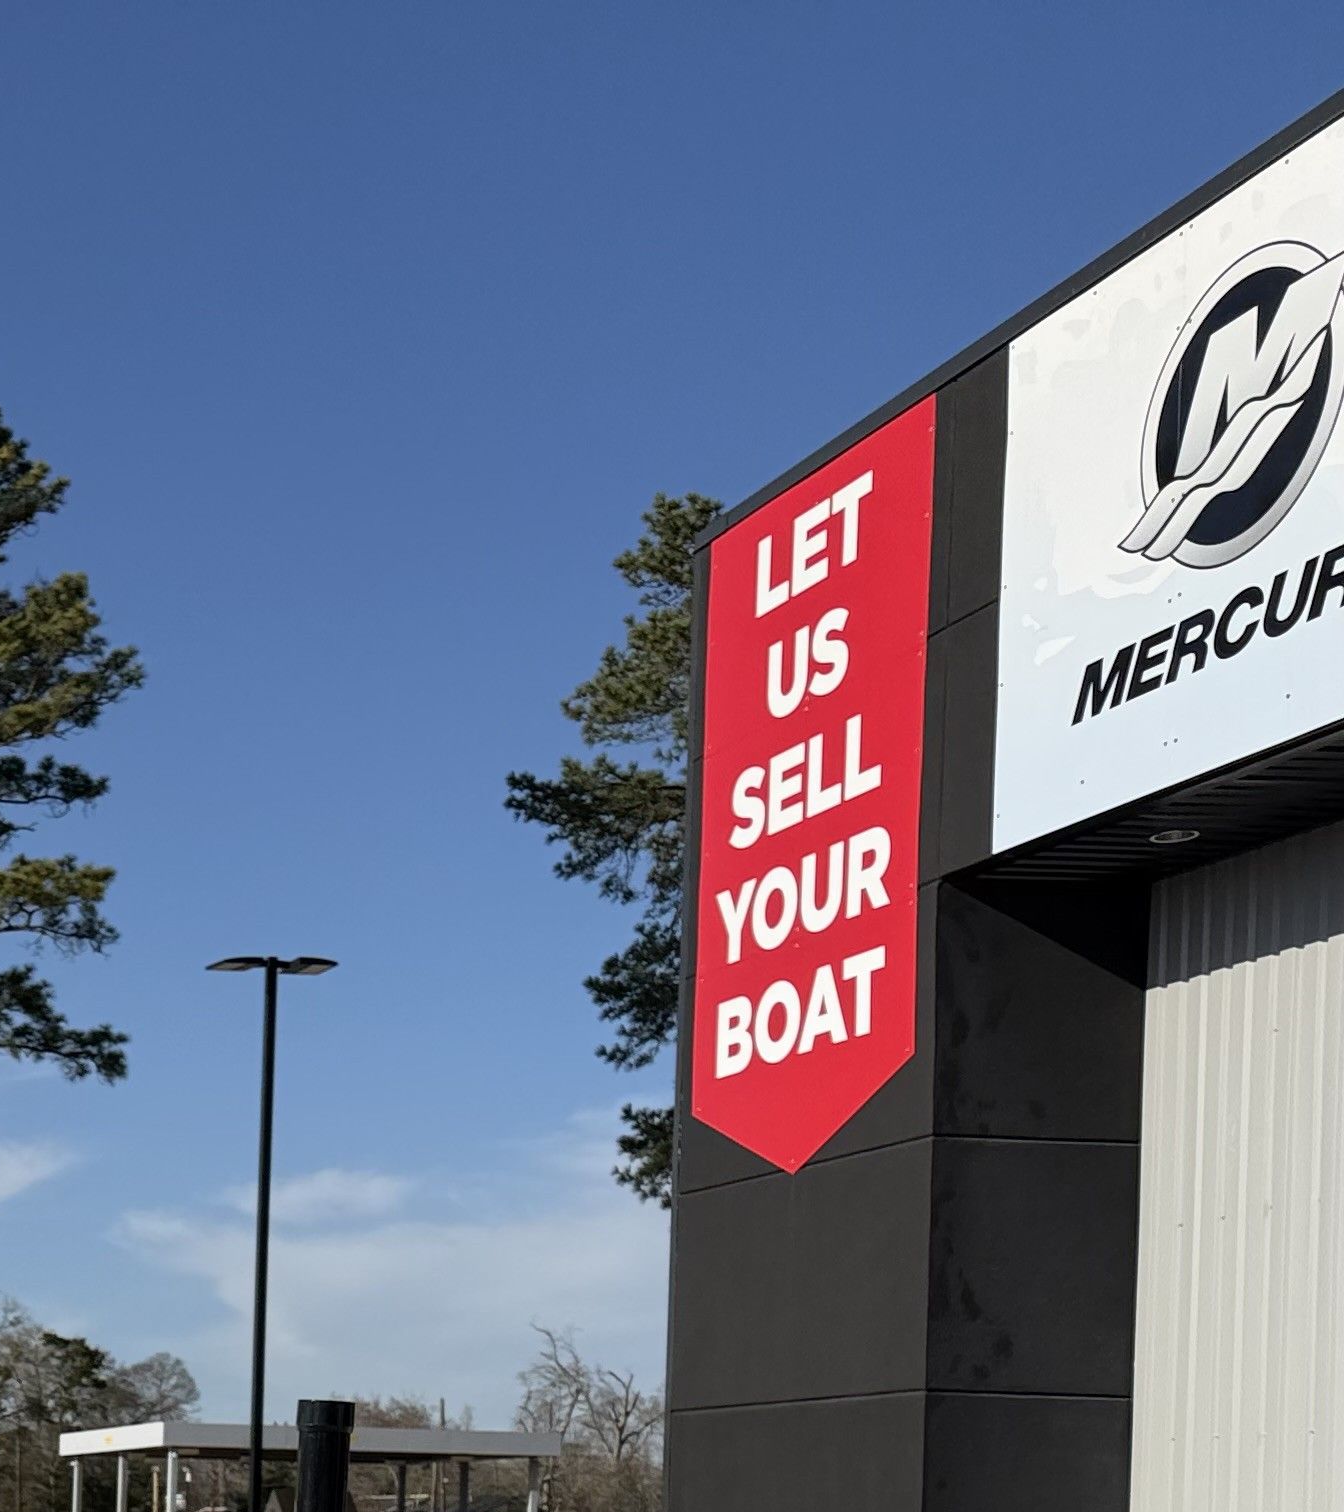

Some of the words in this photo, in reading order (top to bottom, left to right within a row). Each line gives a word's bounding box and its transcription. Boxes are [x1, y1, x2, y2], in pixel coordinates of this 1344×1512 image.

[754, 469, 872, 618] LET
[767, 607, 848, 719] US
[729, 713, 882, 850] SELL
[715, 826, 891, 963] YOUR
[714, 945, 886, 1079] BOAT
